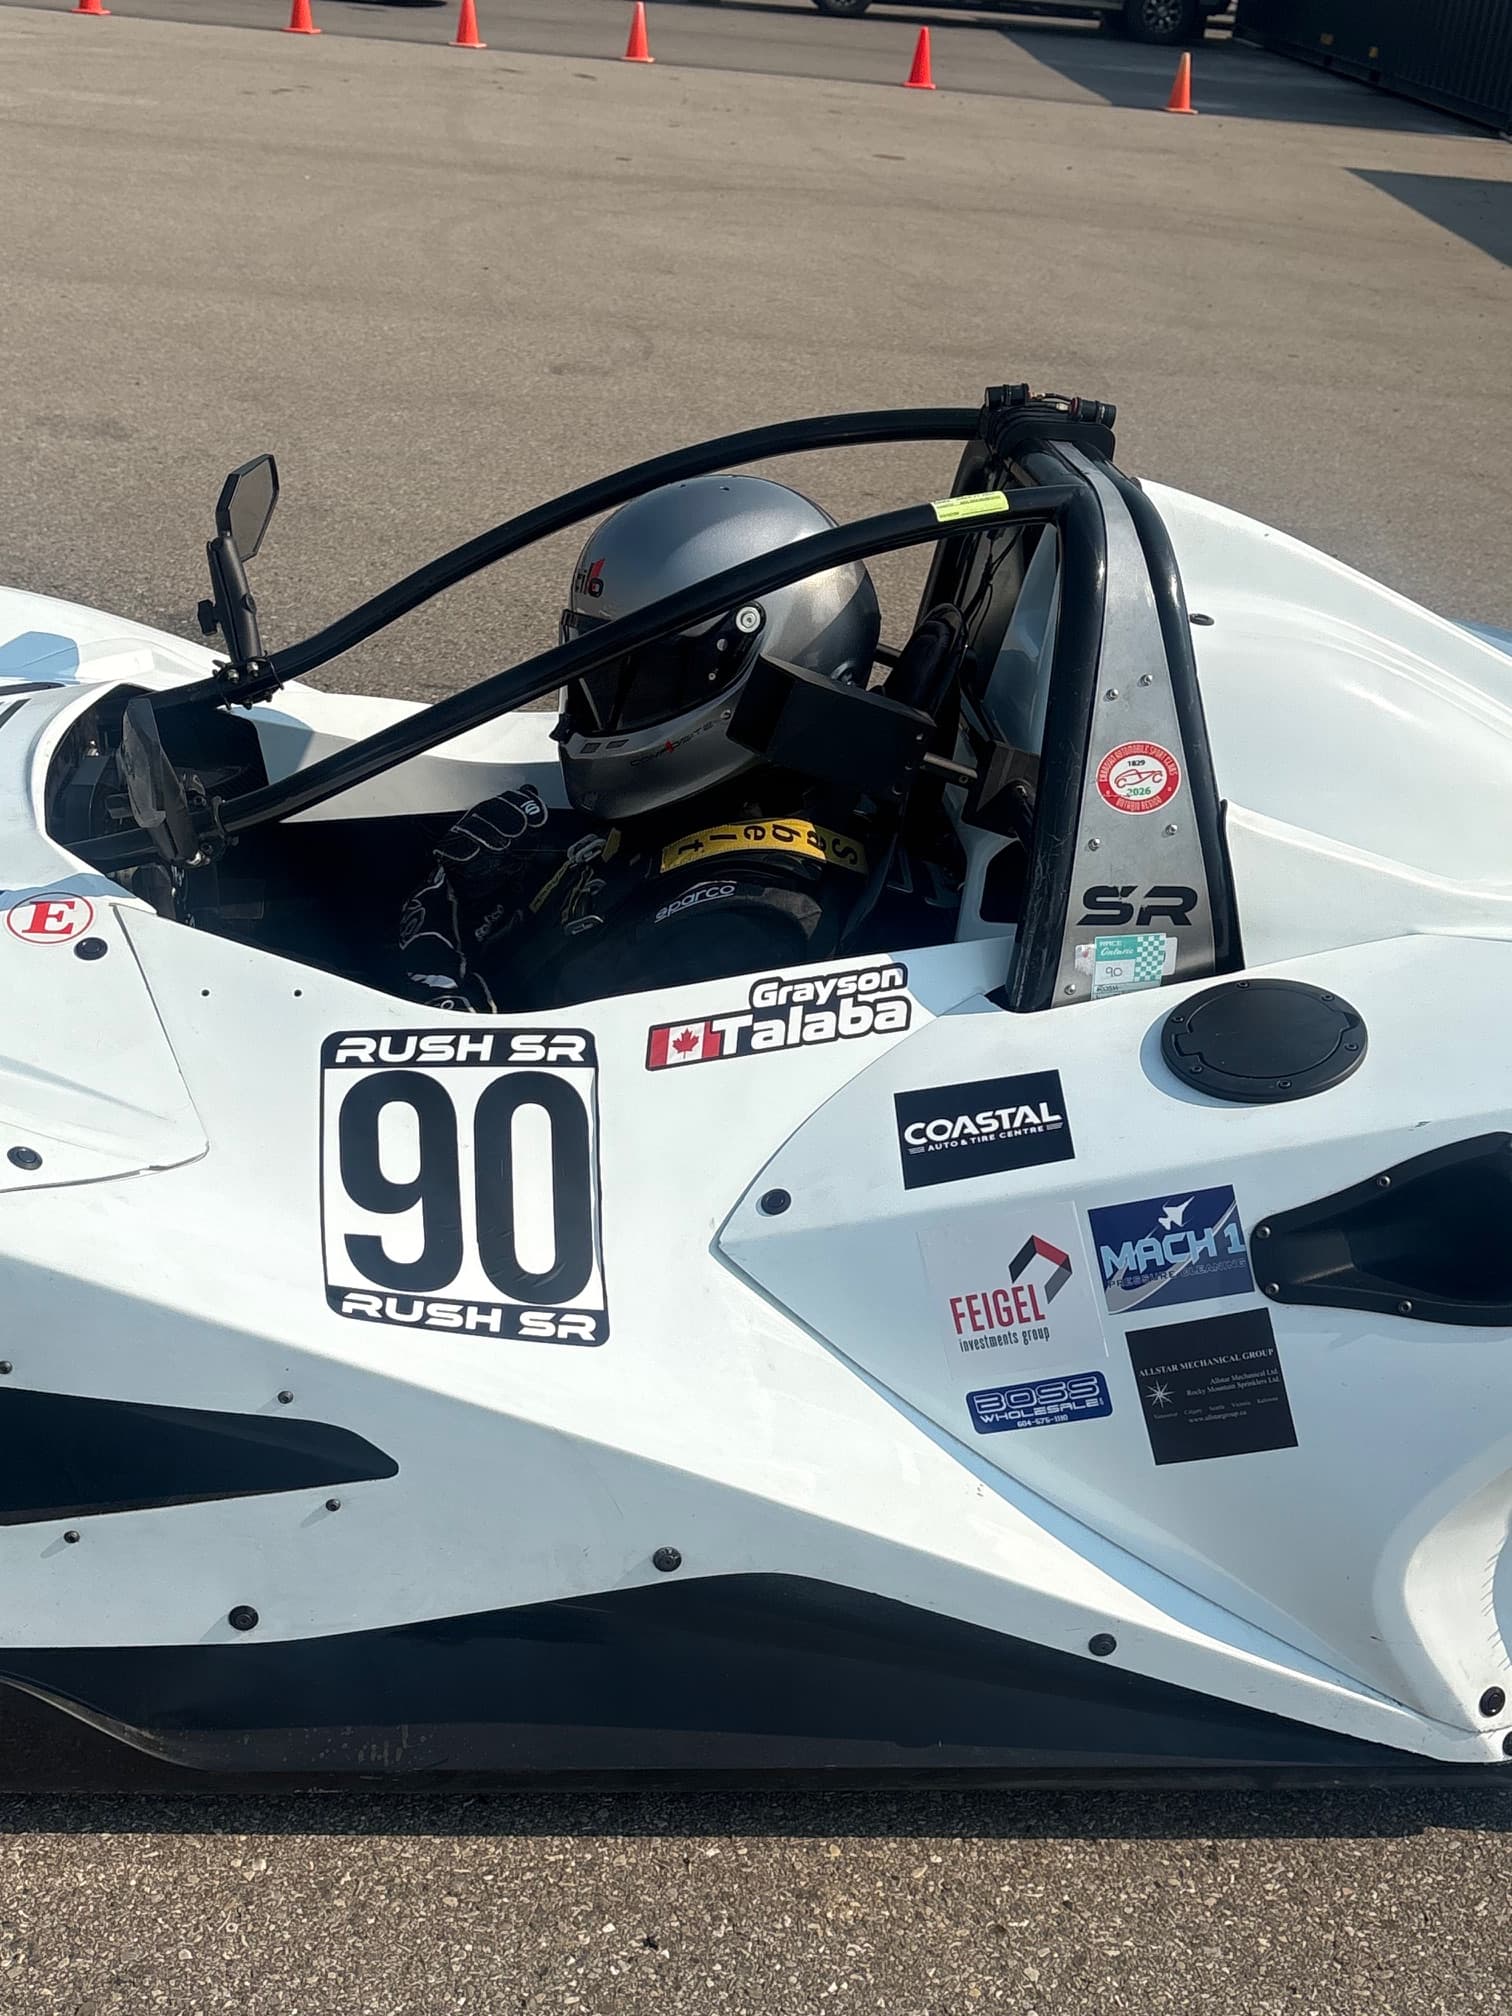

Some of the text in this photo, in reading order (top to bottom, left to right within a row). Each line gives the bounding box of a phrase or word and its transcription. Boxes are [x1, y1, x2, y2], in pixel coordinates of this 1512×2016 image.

[1127, 759, 1146, 767] 1829
[1126, 786, 1152, 797] 2026
[21, 899, 76, 936] E
[1076, 885, 1199, 926] SR
[751, 966, 905, 1009] Grayson
[1105, 966, 1123, 978] 90
[711, 997, 908, 1057] Talaba
[335, 1034, 587, 1063] RUSH SR
[904, 1102, 1062, 1146] COASTAL
[928, 1140, 958, 1152] AUTO
[970, 1134, 996, 1144] TIRE
[999, 1126, 1044, 1139] CENTRE
[339, 1069, 593, 1306] 90
[1100, 1222, 1247, 1279] MACH 1
[341, 1292, 597, 1341] RUSH SR
[949, 1284, 1046, 1335] FEIGEL
[959, 1326, 1050, 1352] investments group
[1139, 1348, 1274, 1377] ALLSTAR MECHANICAL GROUP
[973, 1376, 1101, 1415] BOSS
[980, 1398, 1099, 1424] WHOLESALE
